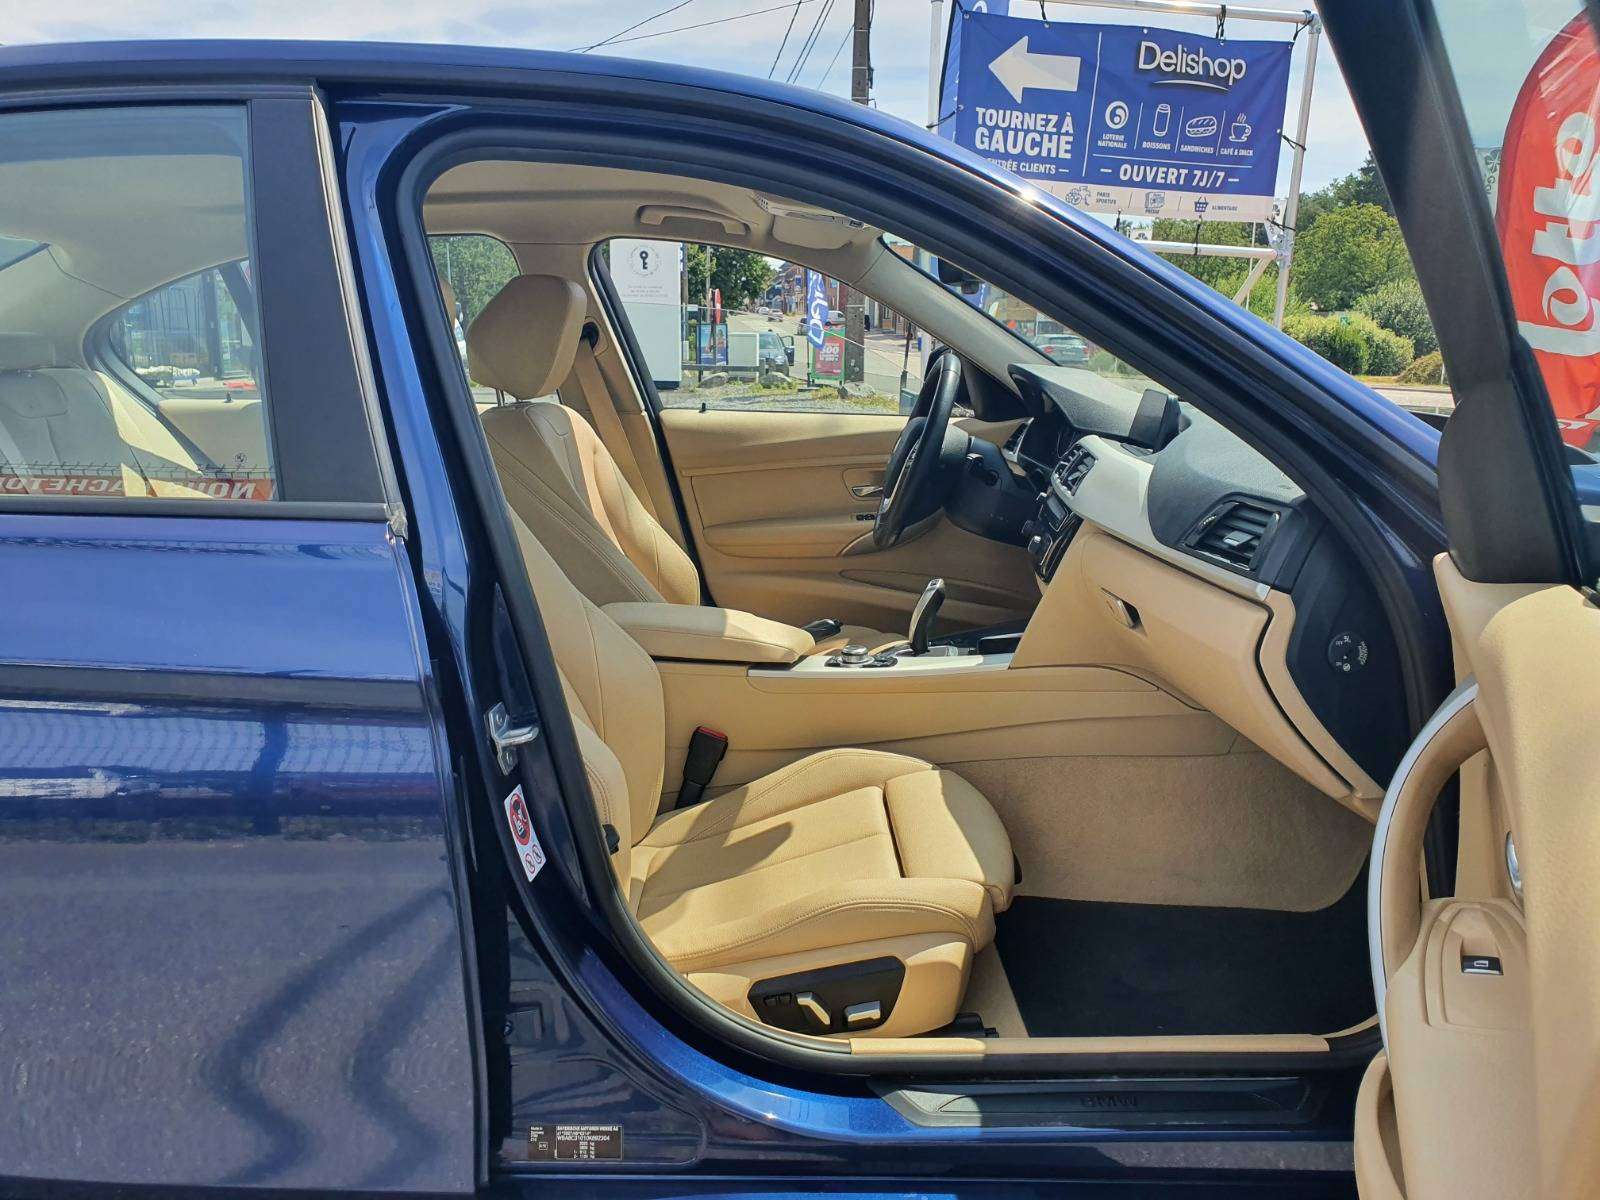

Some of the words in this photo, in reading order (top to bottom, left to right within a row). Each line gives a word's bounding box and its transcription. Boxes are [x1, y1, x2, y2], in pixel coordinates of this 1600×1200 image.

[1139, 41, 1246, 85] Delishop
[976, 107, 1058, 132] TOURNEZ
[1061, 112, 1074, 133] À
[975, 127, 1074, 158] GAUCHE
[1097, 140, 1128, 149] NATIONALE
[1142, 141, 1171, 150] BOISSONS
[1180, 144, 1214, 154] SANDWICHES
[1020, 162, 1056, 175] CLIENTS
[1119, 164, 1188, 185] OUVERT
[1191, 169, 1226, 188] 7J/7
